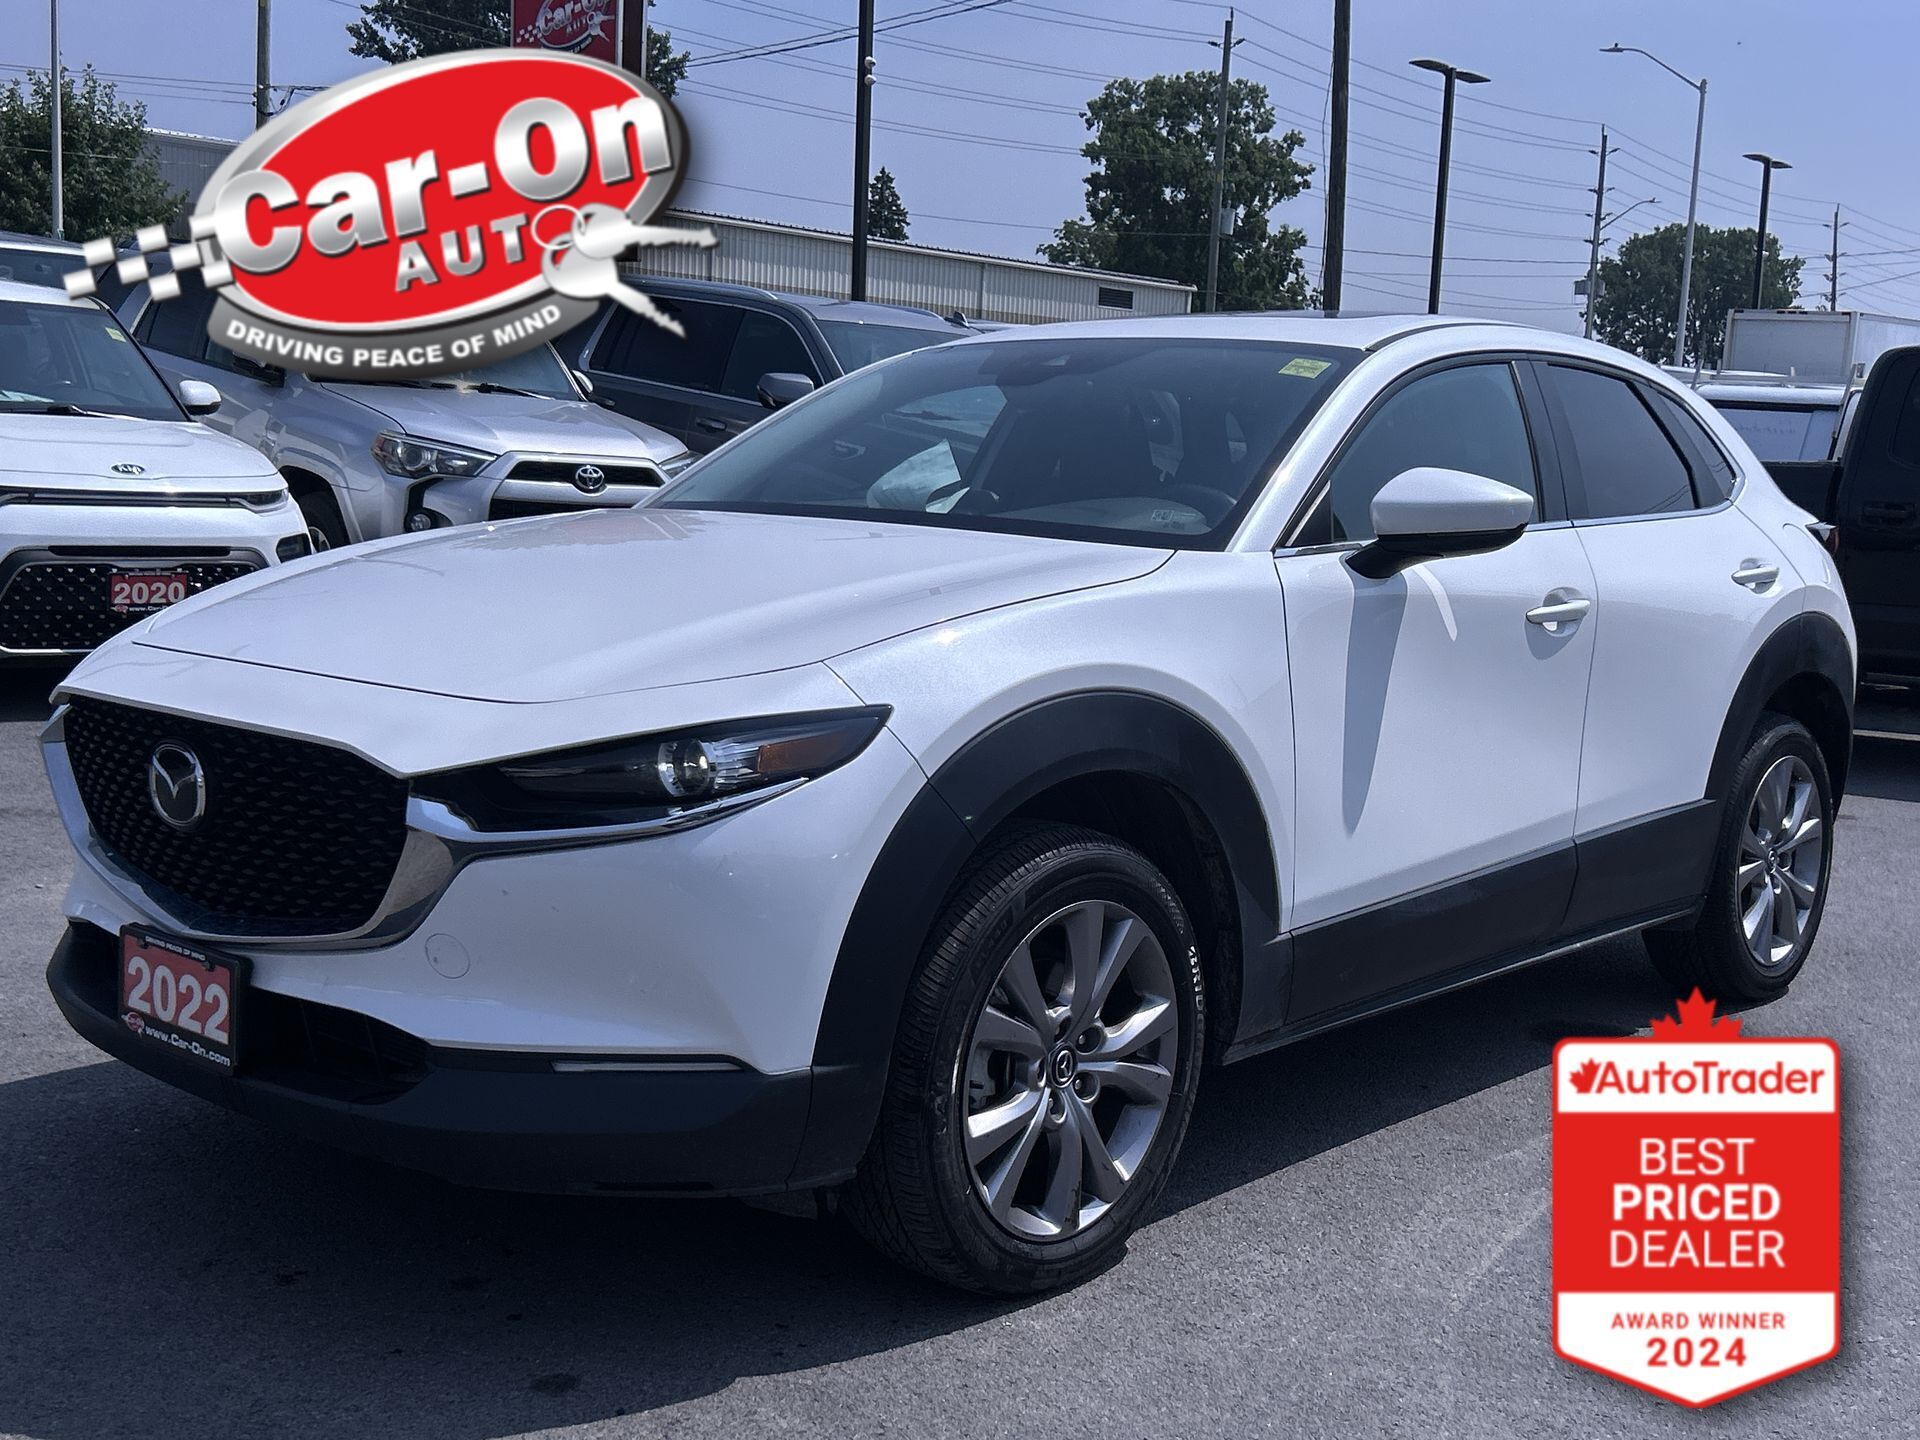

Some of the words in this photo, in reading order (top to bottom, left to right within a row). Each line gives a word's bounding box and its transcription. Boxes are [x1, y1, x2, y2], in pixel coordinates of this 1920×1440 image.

[114, 582, 185, 604] 2020
[128, 956, 229, 1045] 2022
[145, 1025, 231, 1067] www.Car-On.com
